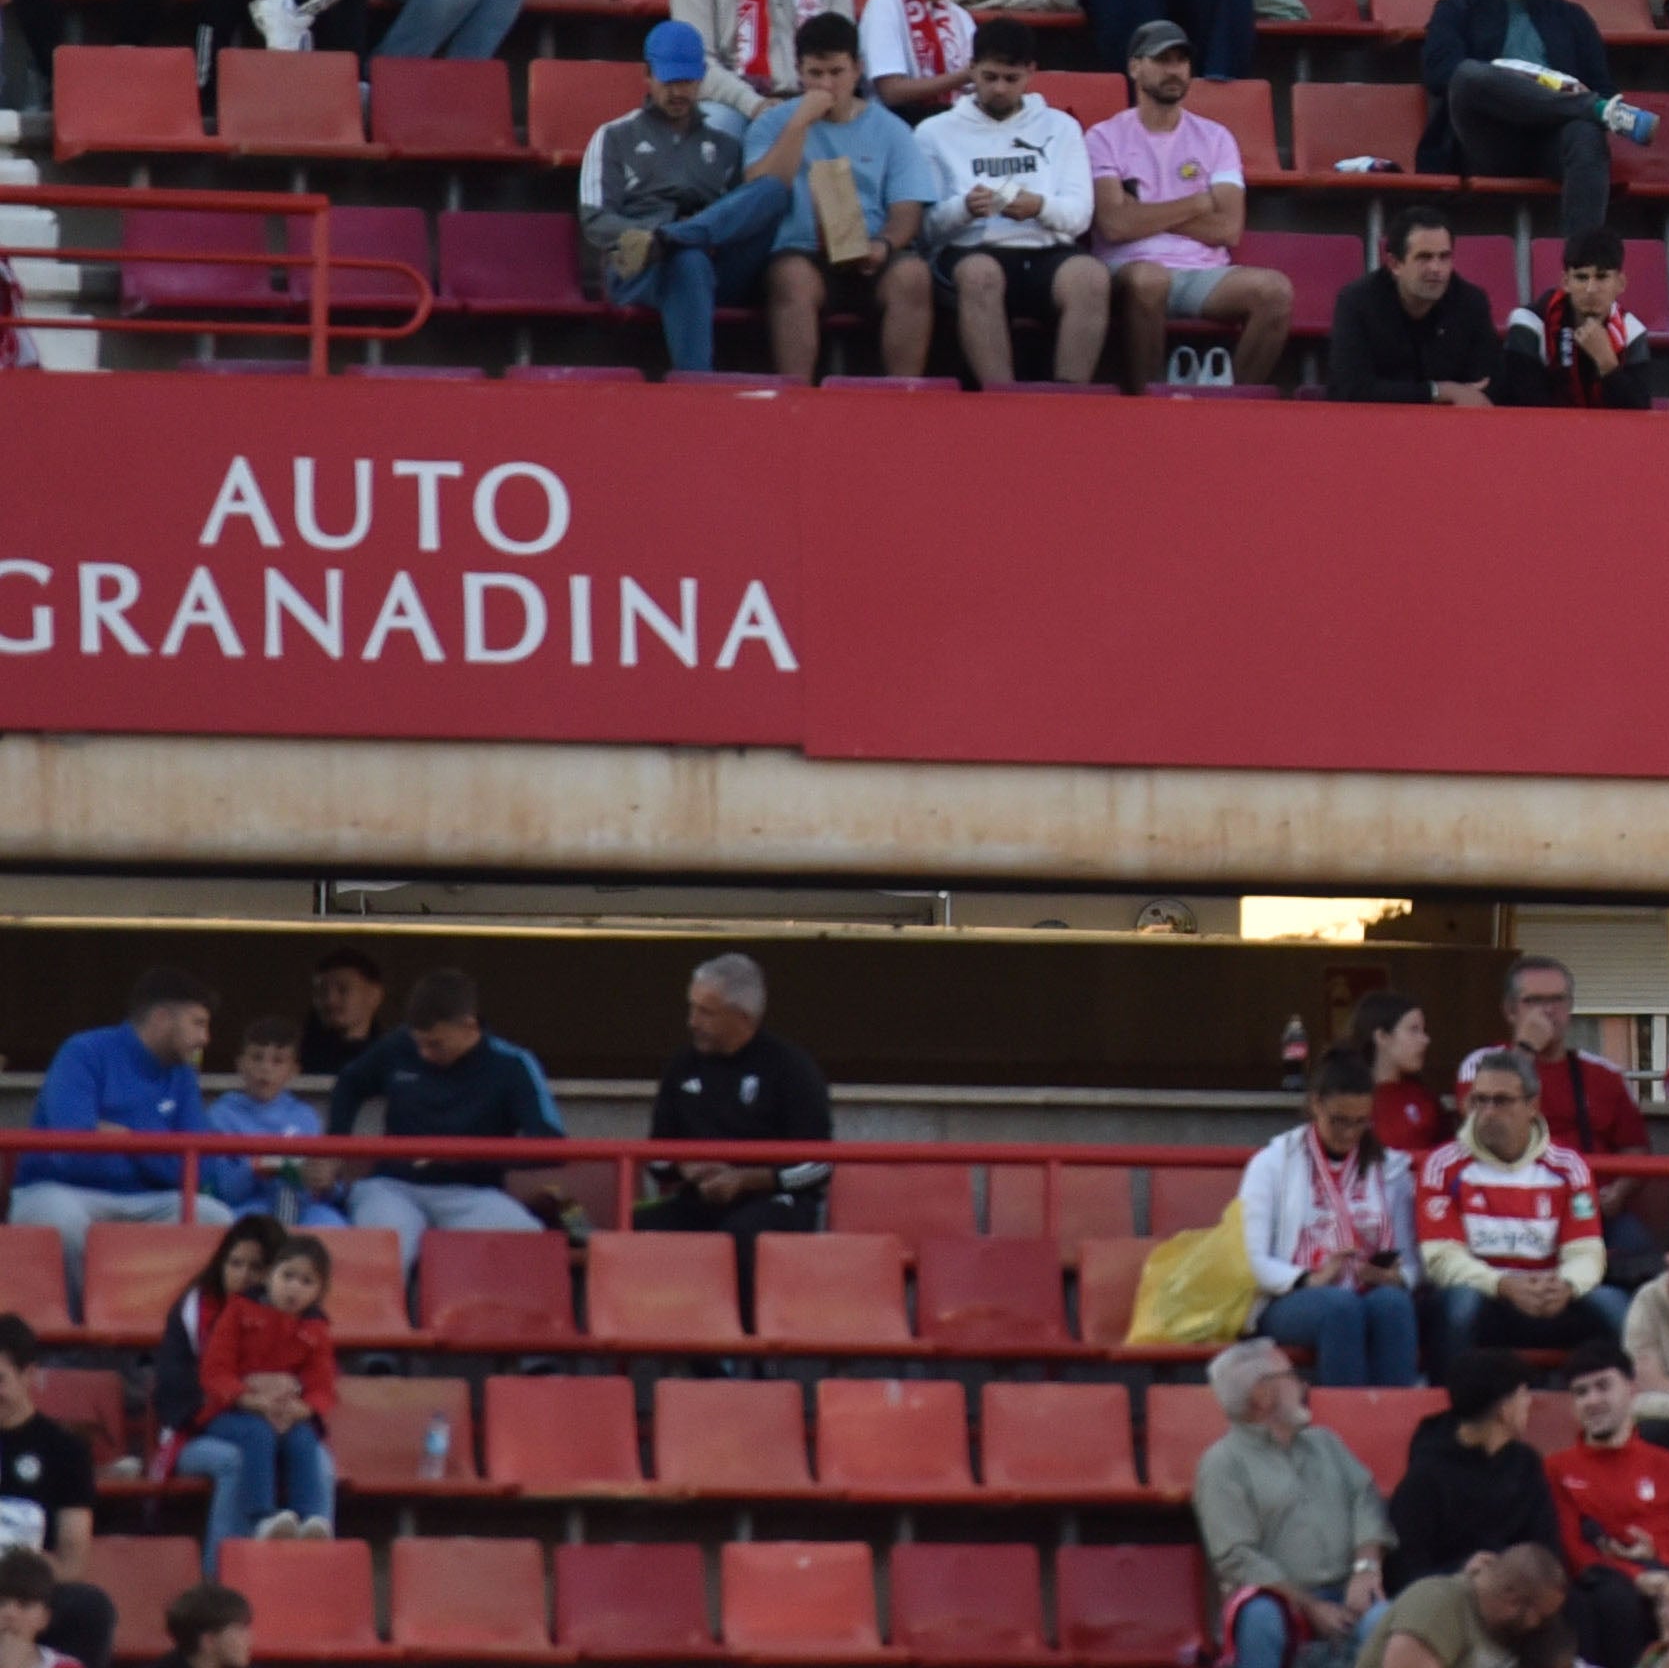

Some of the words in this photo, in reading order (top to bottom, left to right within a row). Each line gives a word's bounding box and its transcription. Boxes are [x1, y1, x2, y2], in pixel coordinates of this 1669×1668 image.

[971, 155, 1037, 178] PUMA
[199, 455, 571, 555] AUTO
[0, 558, 799, 671] GRANADINA
